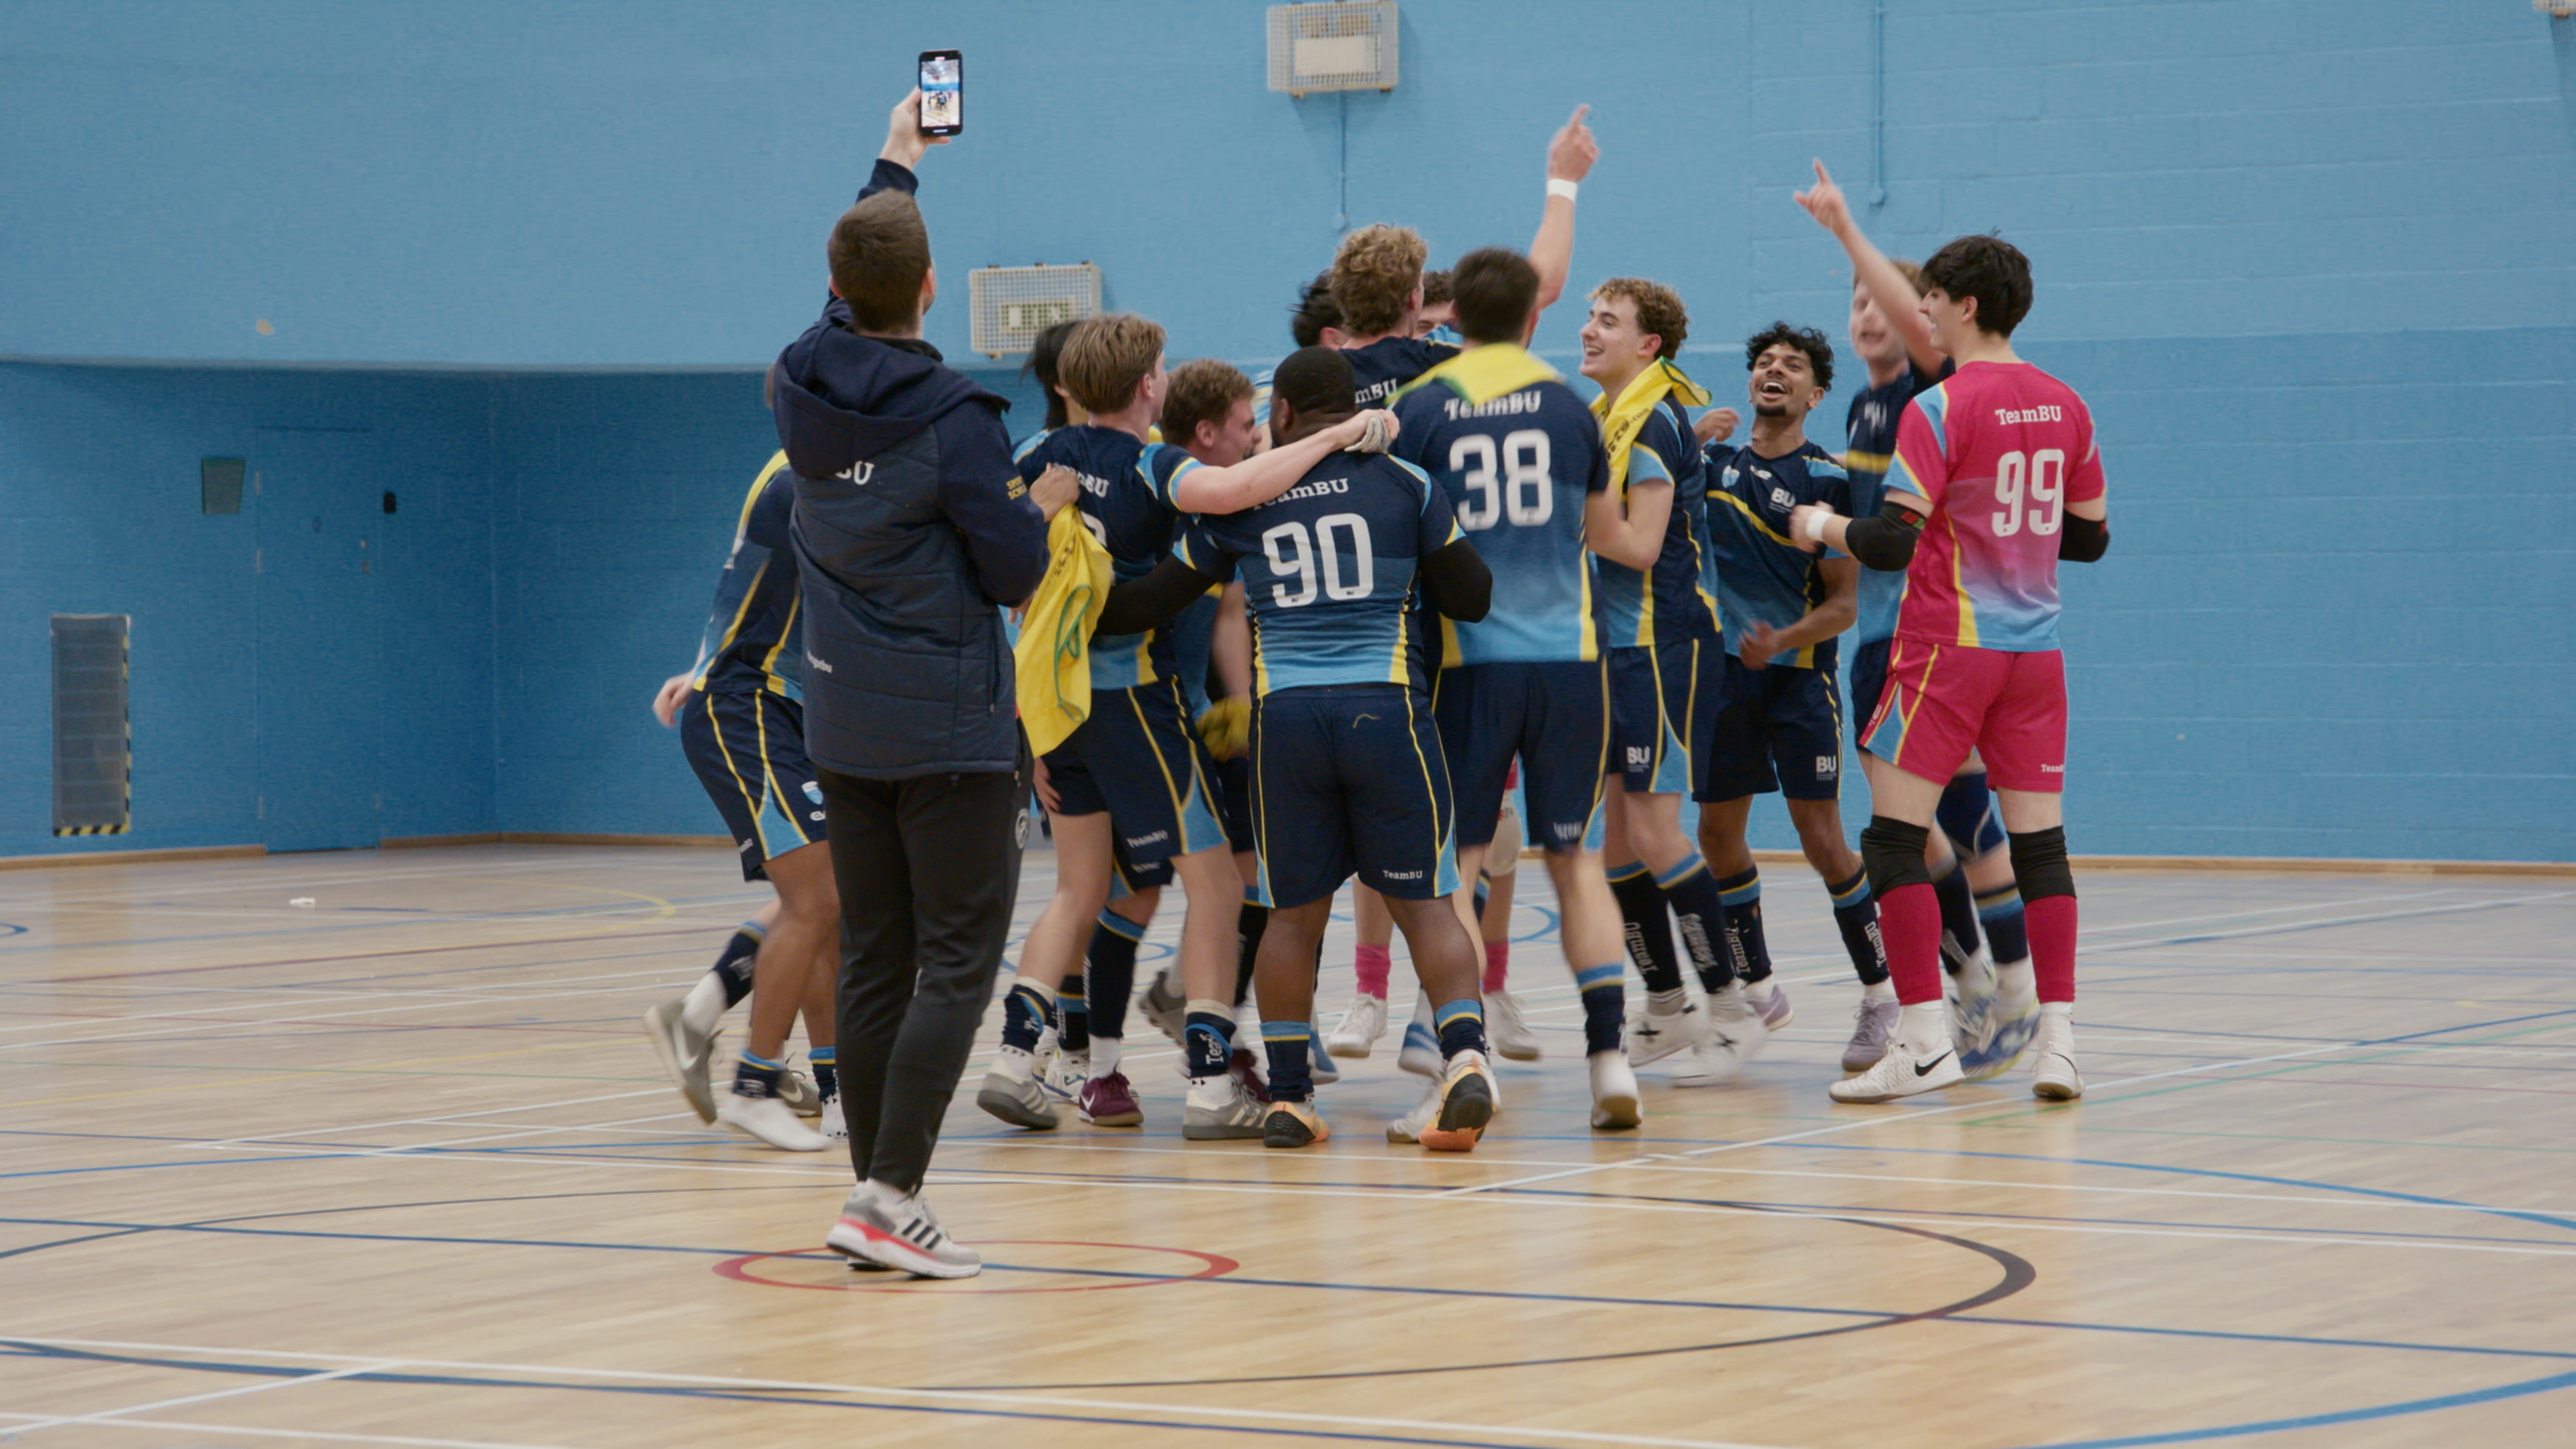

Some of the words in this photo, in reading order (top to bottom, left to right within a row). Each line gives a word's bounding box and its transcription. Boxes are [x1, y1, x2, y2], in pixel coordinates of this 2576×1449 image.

[1995, 405, 2061, 425] TeamBU
[1450, 429, 1553, 531] 38
[1772, 487, 1796, 508] BU
[1992, 449, 2065, 537] 99
[1262, 513, 1374, 608] 90
[1627, 745, 1650, 764] BU
[1816, 755, 1837, 772] BU
[1383, 869, 1423, 879] TeamBU
